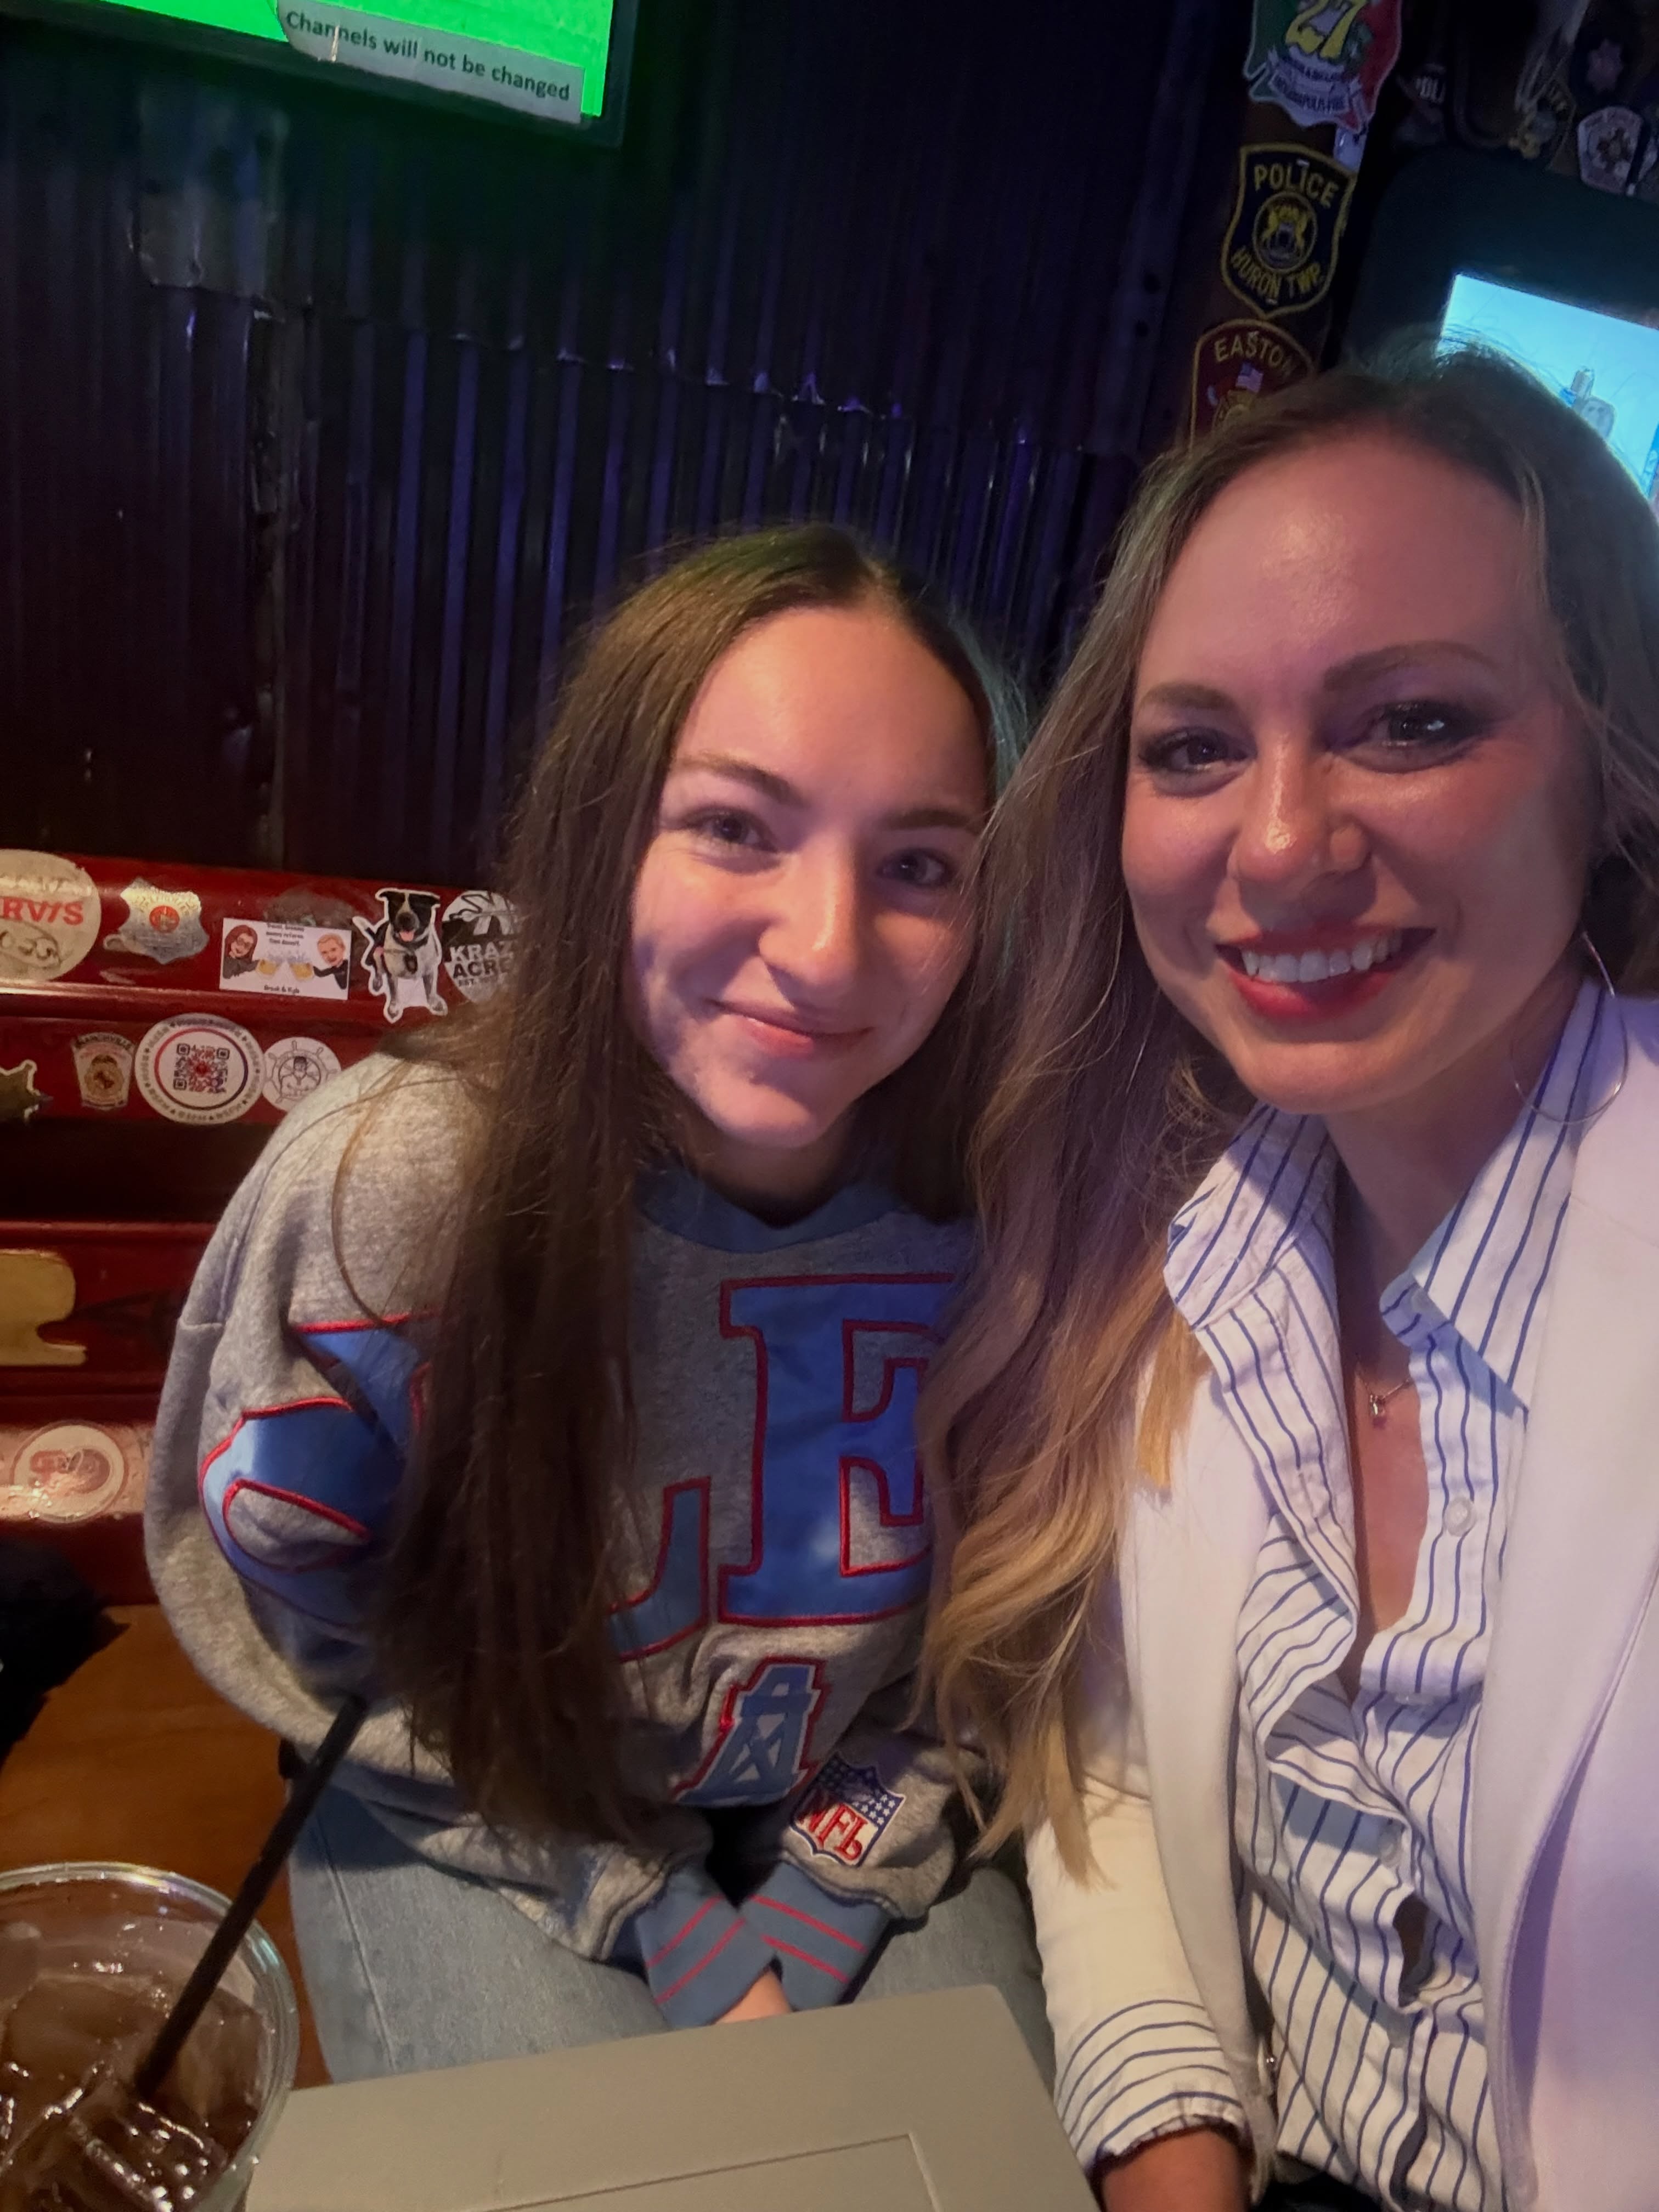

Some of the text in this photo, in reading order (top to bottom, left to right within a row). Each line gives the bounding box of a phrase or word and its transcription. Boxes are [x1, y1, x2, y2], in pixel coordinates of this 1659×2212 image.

[286, 10, 570, 100] Channels will not be changed
[1254, 162, 1339, 209] POLICE
[1231, 245, 1282, 300] HURON
[798, 1795, 868, 1860] NFL
